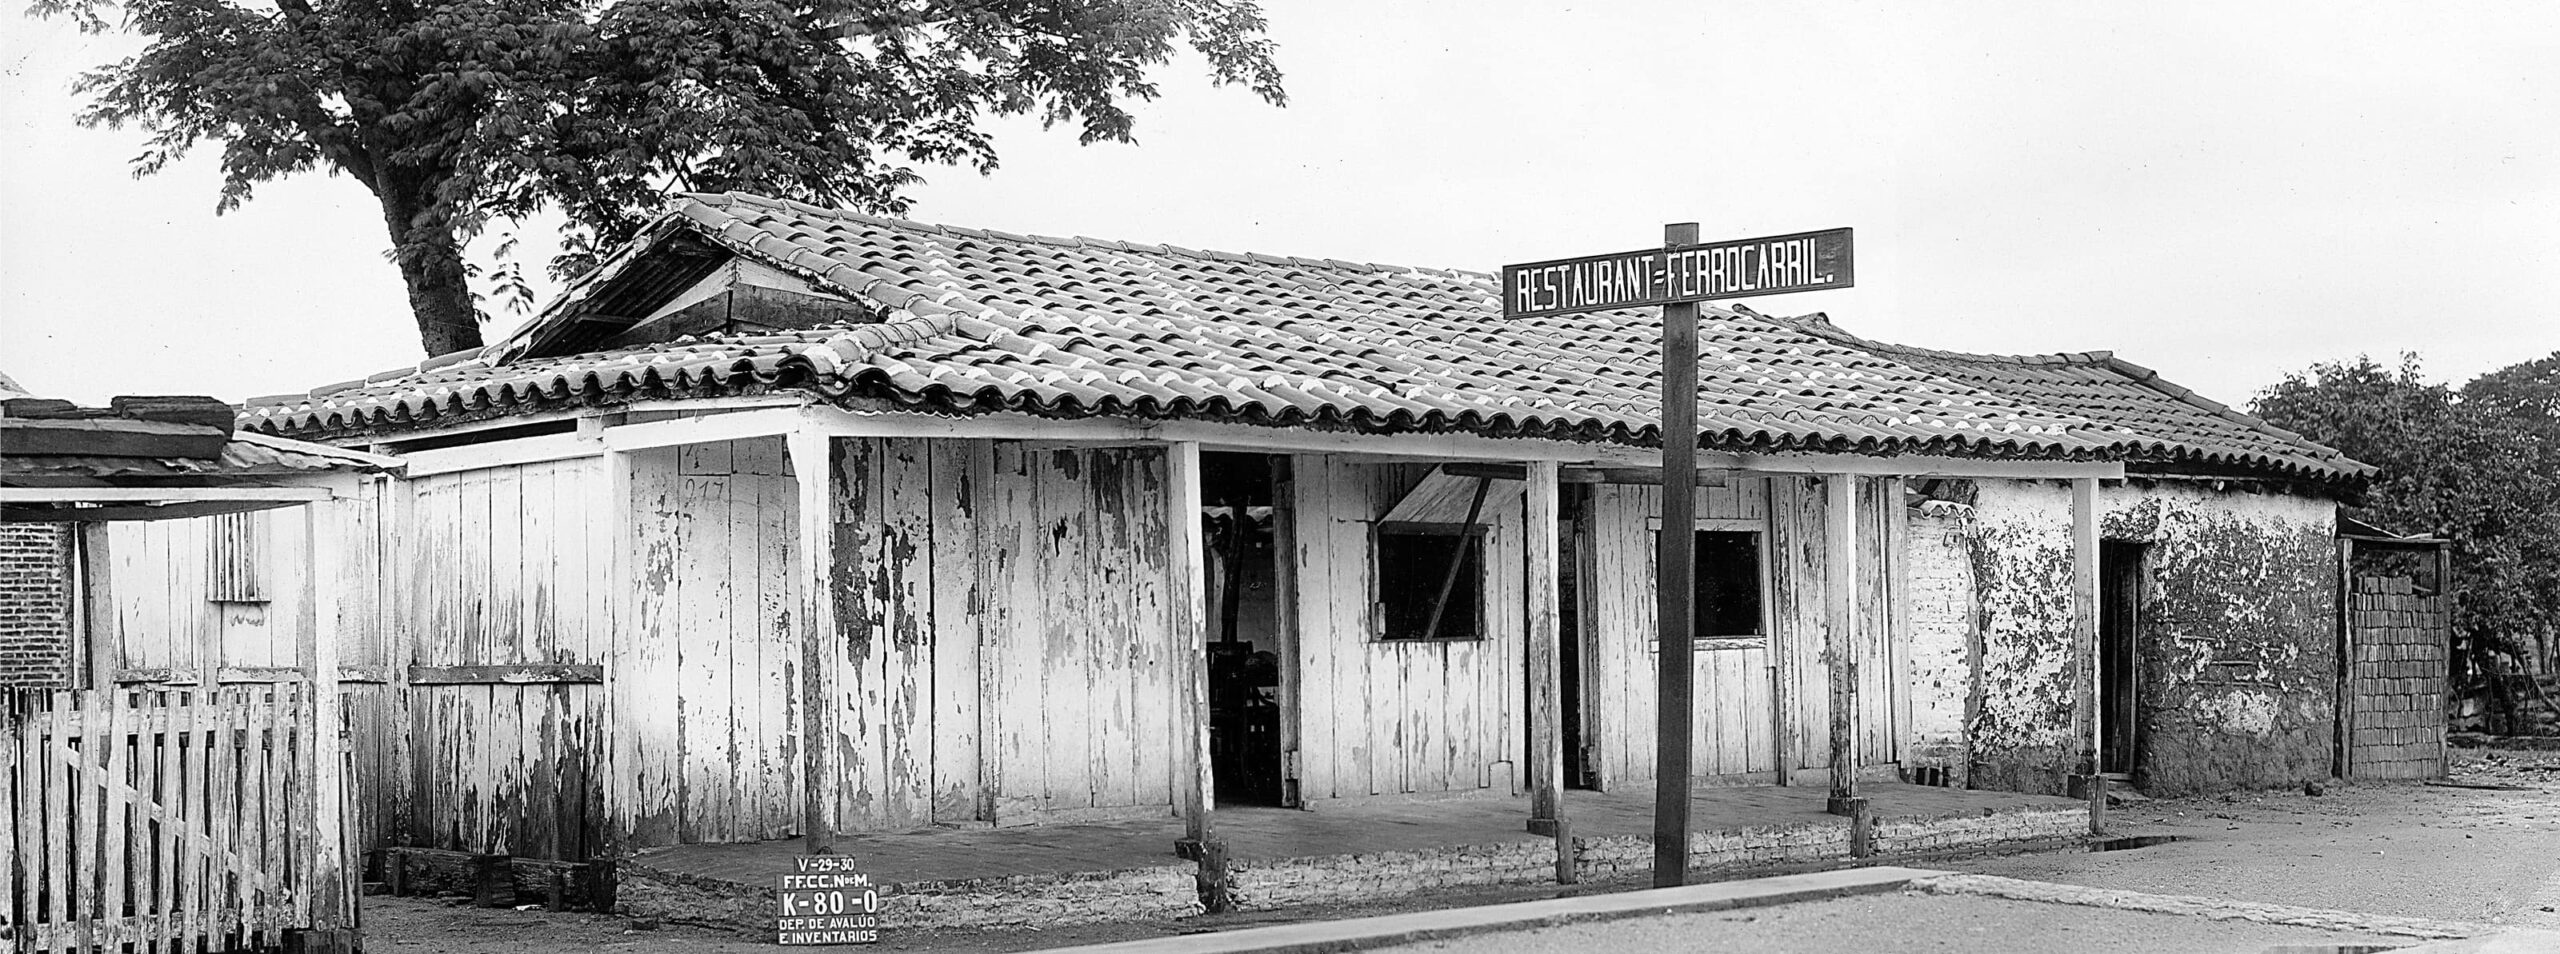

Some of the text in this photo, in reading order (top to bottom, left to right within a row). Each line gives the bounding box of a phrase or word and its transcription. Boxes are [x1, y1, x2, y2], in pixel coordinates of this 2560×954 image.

[797, 858, 855, 872] V-29-30
[779, 913, 875, 931] DEP. DE AVALÚO
[779, 930, 878, 945] E INVENTARIOS
